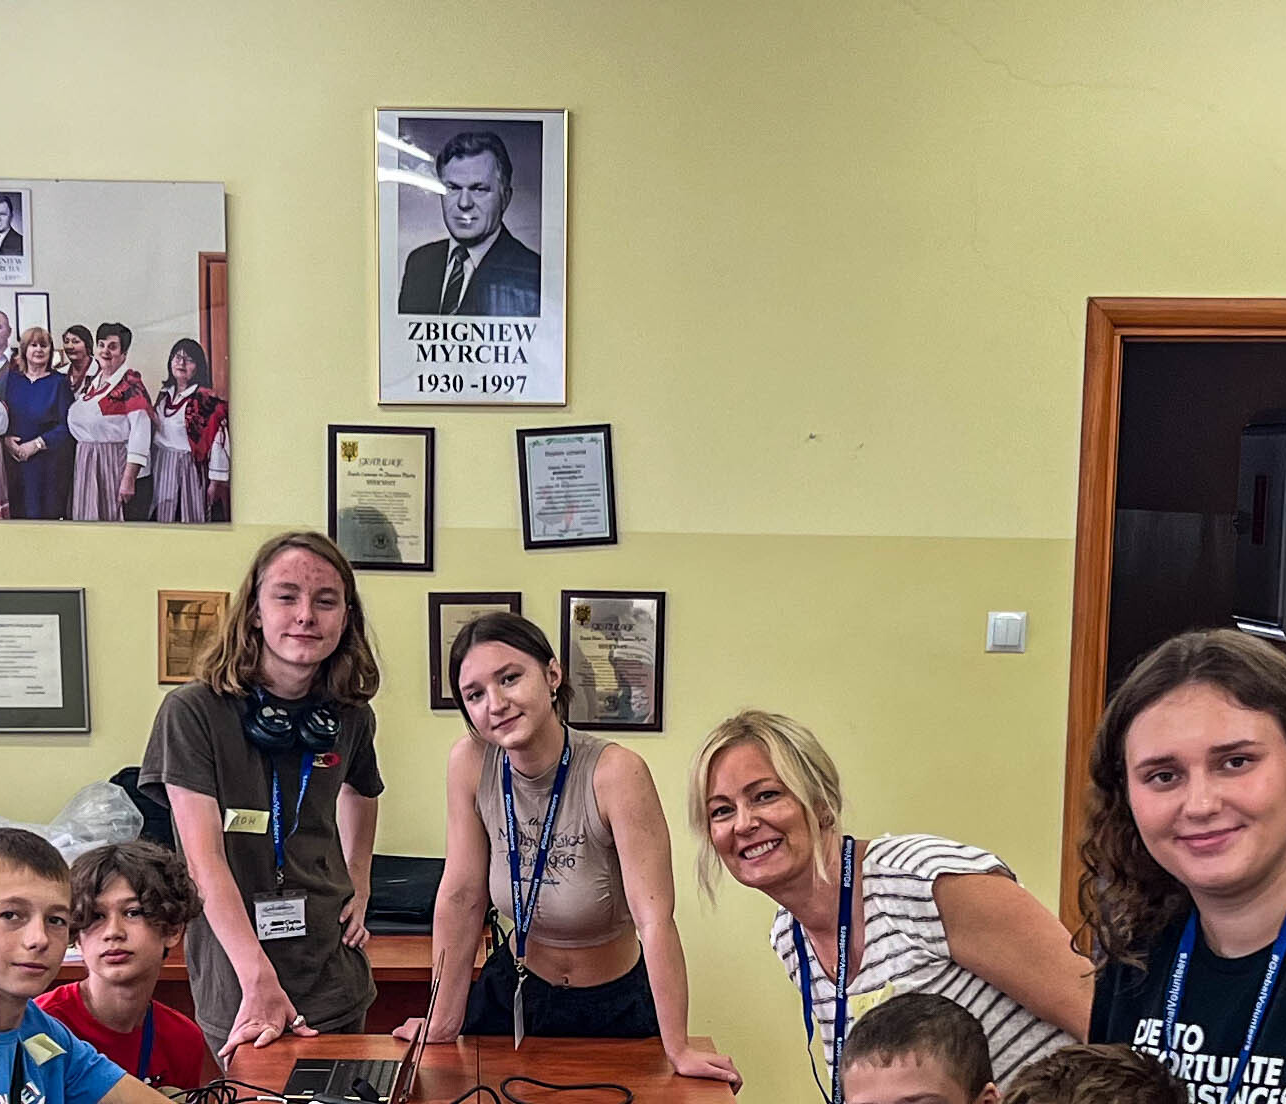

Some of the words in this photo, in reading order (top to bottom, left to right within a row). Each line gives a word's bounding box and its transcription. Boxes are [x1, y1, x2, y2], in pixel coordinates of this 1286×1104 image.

[408, 322, 537, 342] ZBIGNIEW
[416, 344, 529, 364] MYRCHA
[417, 374, 464, 393] 1930
[1244, 953, 1280, 1051] #GlobalVolunteers
[1172, 1022, 1204, 1053] TO
